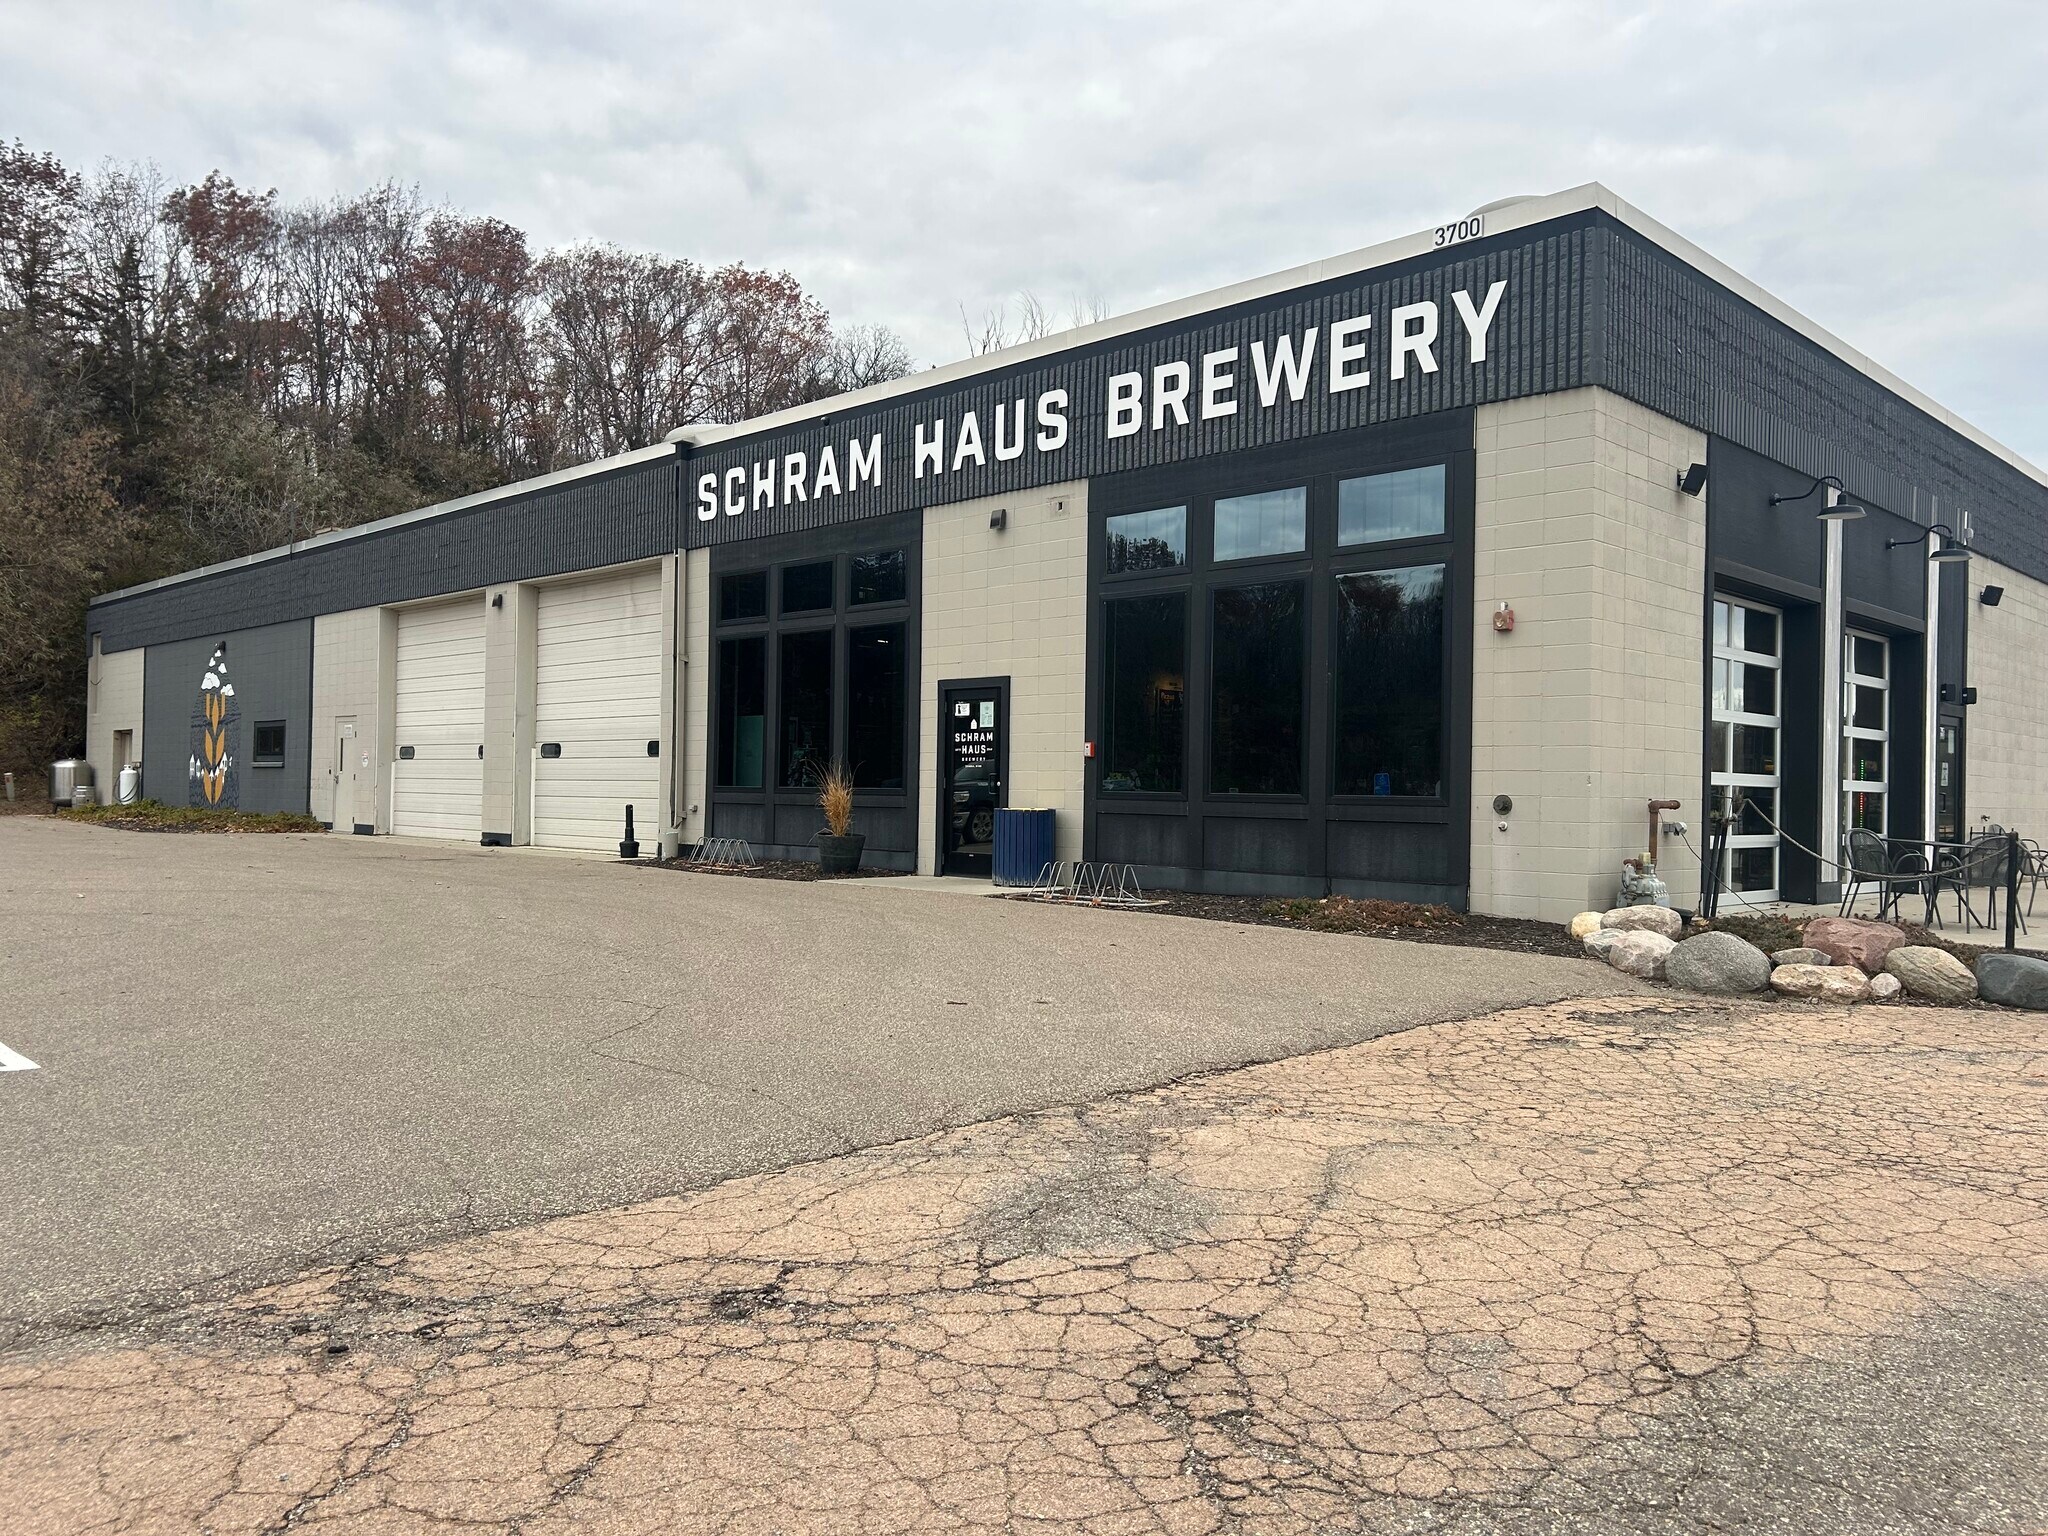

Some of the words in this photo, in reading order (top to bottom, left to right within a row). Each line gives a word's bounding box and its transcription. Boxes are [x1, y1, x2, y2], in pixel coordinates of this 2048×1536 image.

[1434, 217, 1480, 247] 3700
[697, 433, 883, 522] SCHRAM
[914, 388, 1068, 479] HAUS
[1107, 279, 1508, 439] BREWERY
[954, 732, 993, 742] SCHRAM
[961, 745, 986, 754] HAUS
